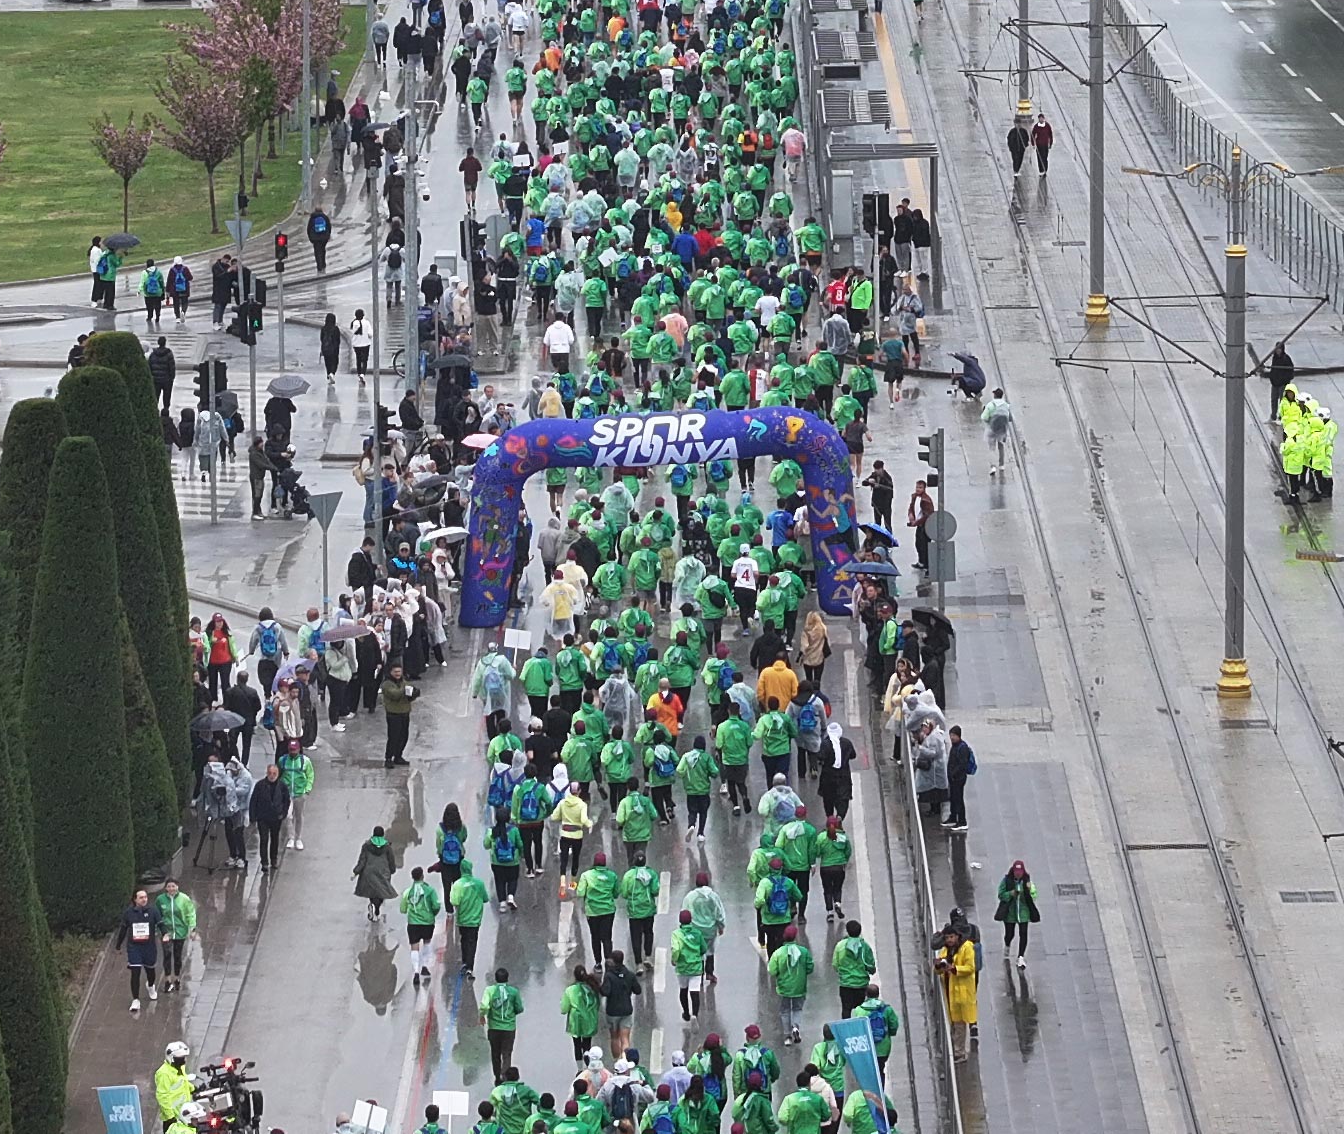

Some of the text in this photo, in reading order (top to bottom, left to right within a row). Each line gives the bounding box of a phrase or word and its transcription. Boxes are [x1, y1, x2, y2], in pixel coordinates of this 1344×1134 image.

[589, 413, 706, 454] SPOR
[592, 435, 738, 466] KONYA
[741, 568, 751, 582] 4
